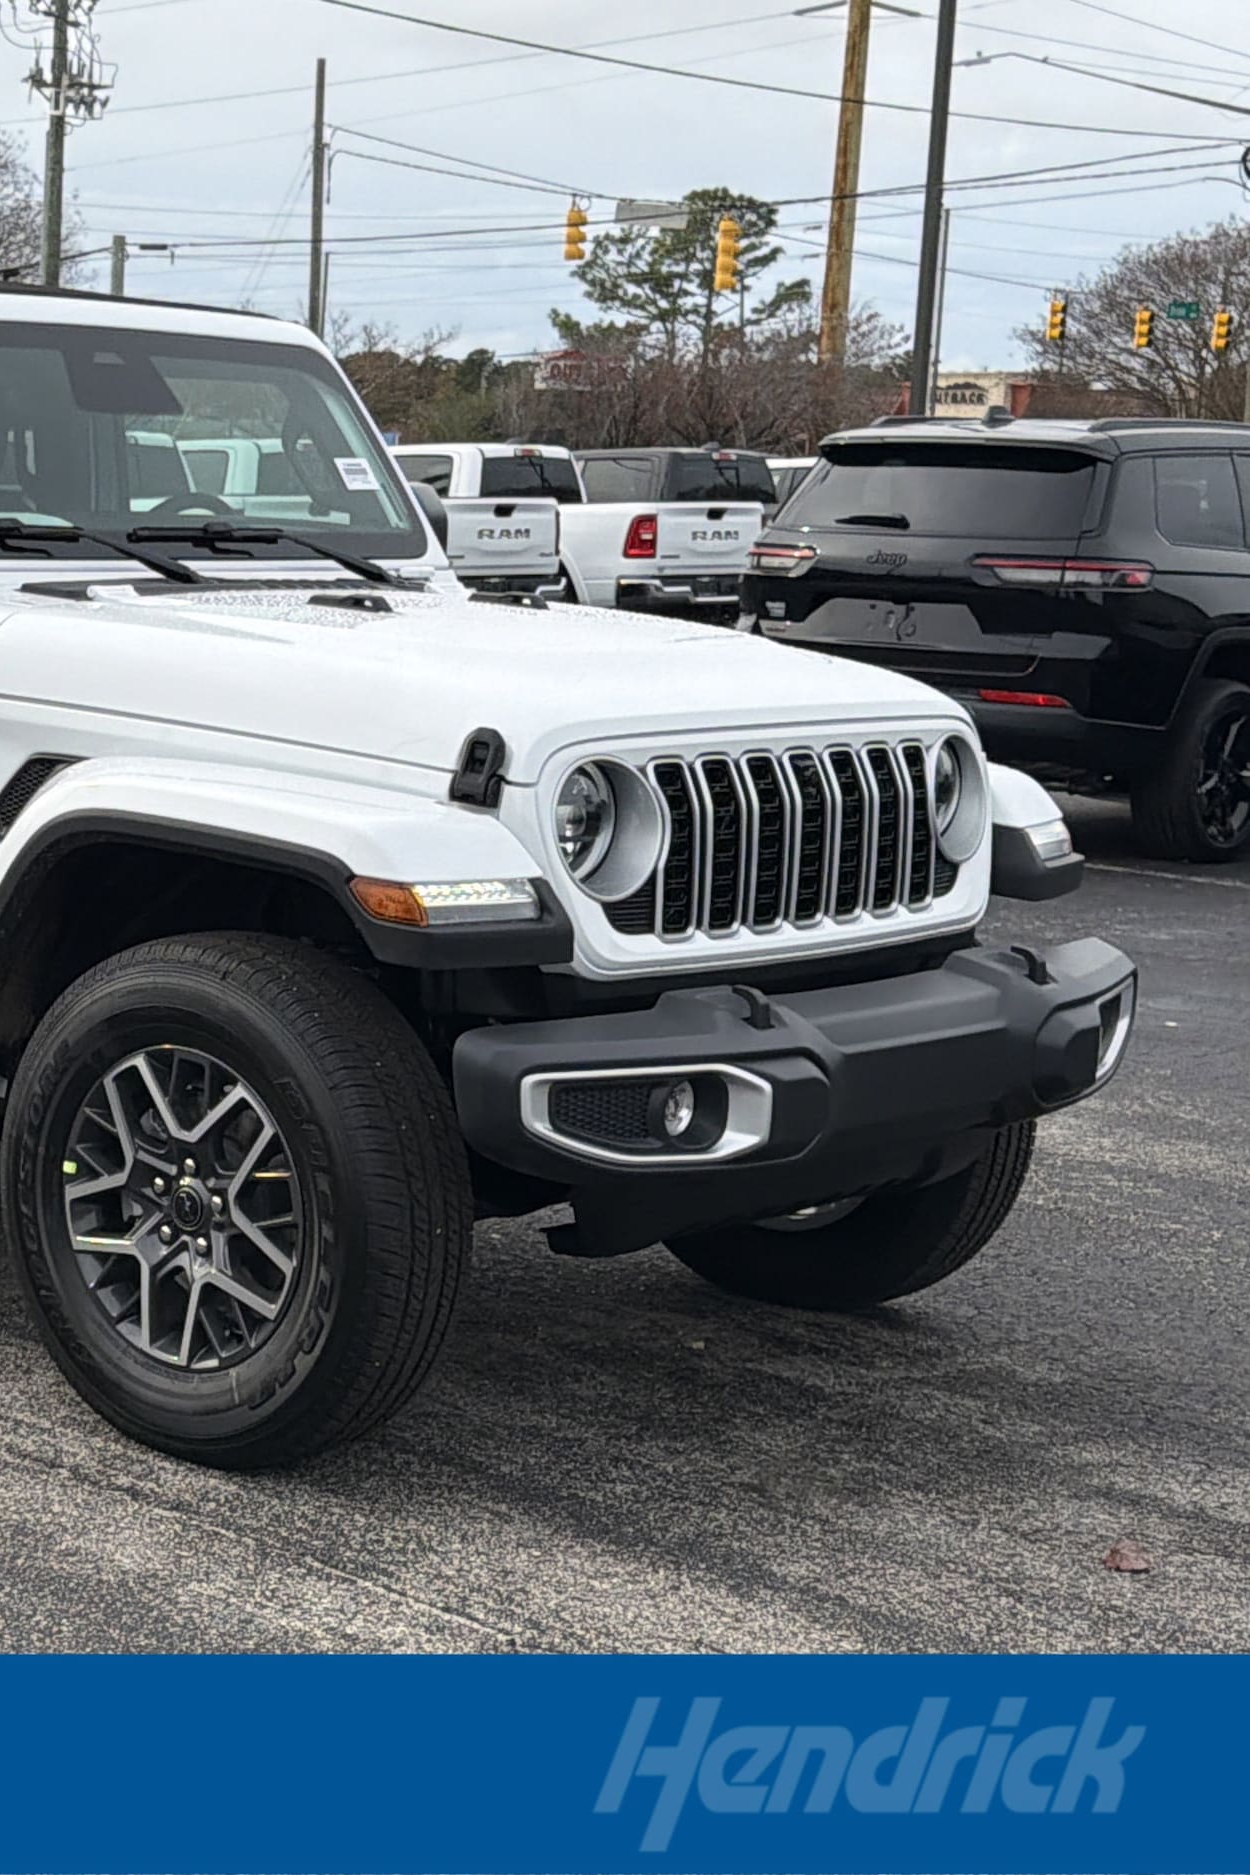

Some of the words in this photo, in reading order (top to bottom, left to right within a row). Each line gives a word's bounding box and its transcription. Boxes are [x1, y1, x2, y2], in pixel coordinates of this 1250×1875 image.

[934, 391, 986, 405] UTBACK
[478, 528, 530, 540] RAM
[691, 530, 739, 541] RAM
[866, 549, 908, 568] Jeep
